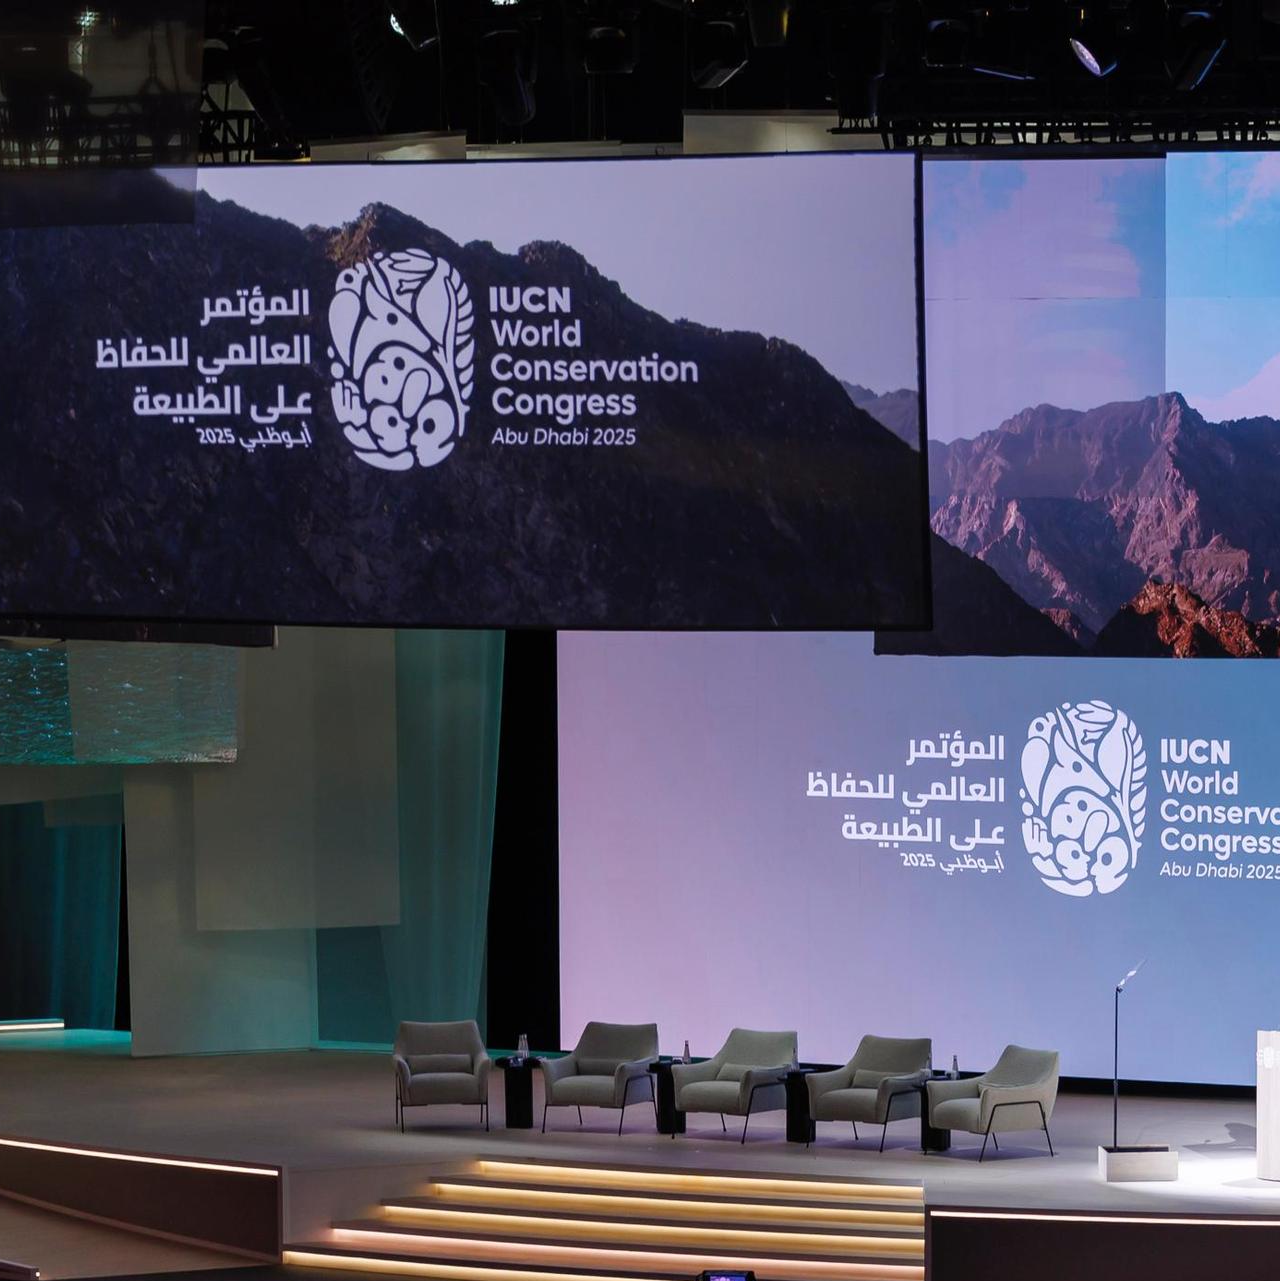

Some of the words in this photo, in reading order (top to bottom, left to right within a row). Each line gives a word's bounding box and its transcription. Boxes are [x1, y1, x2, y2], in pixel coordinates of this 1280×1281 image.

[199, 285, 310, 327] المؤتمر
[488, 285, 571, 314] IUCN
[490, 318, 582, 348] World
[95, 336, 190, 369] للحفاظ
[196, 334, 311, 384] العالمي
[490, 352, 699, 383] Conservation
[132, 384, 242, 424] الطبيعة
[249, 384, 313, 424] على
[491, 386, 637, 426] Congress
[195, 427, 236, 445] 2025
[491, 426, 529, 446] Abu
[533, 427, 589, 446] Dhabi
[592, 427, 637, 446] 2025
[905, 729, 1005, 768] المؤتمر
[1160, 738, 1231, 765] IUCN
[806, 771, 895, 799] للحفاظ
[901, 776, 1005, 815] العالمي
[1161, 769, 1239, 795] World
[841, 813, 942, 849] الطبيعة
[949, 818, 1005, 852] على
[899, 852, 936, 868] 2025
[1159, 861, 1192, 877] Abu
[1195, 862, 1243, 879] Dhabi
